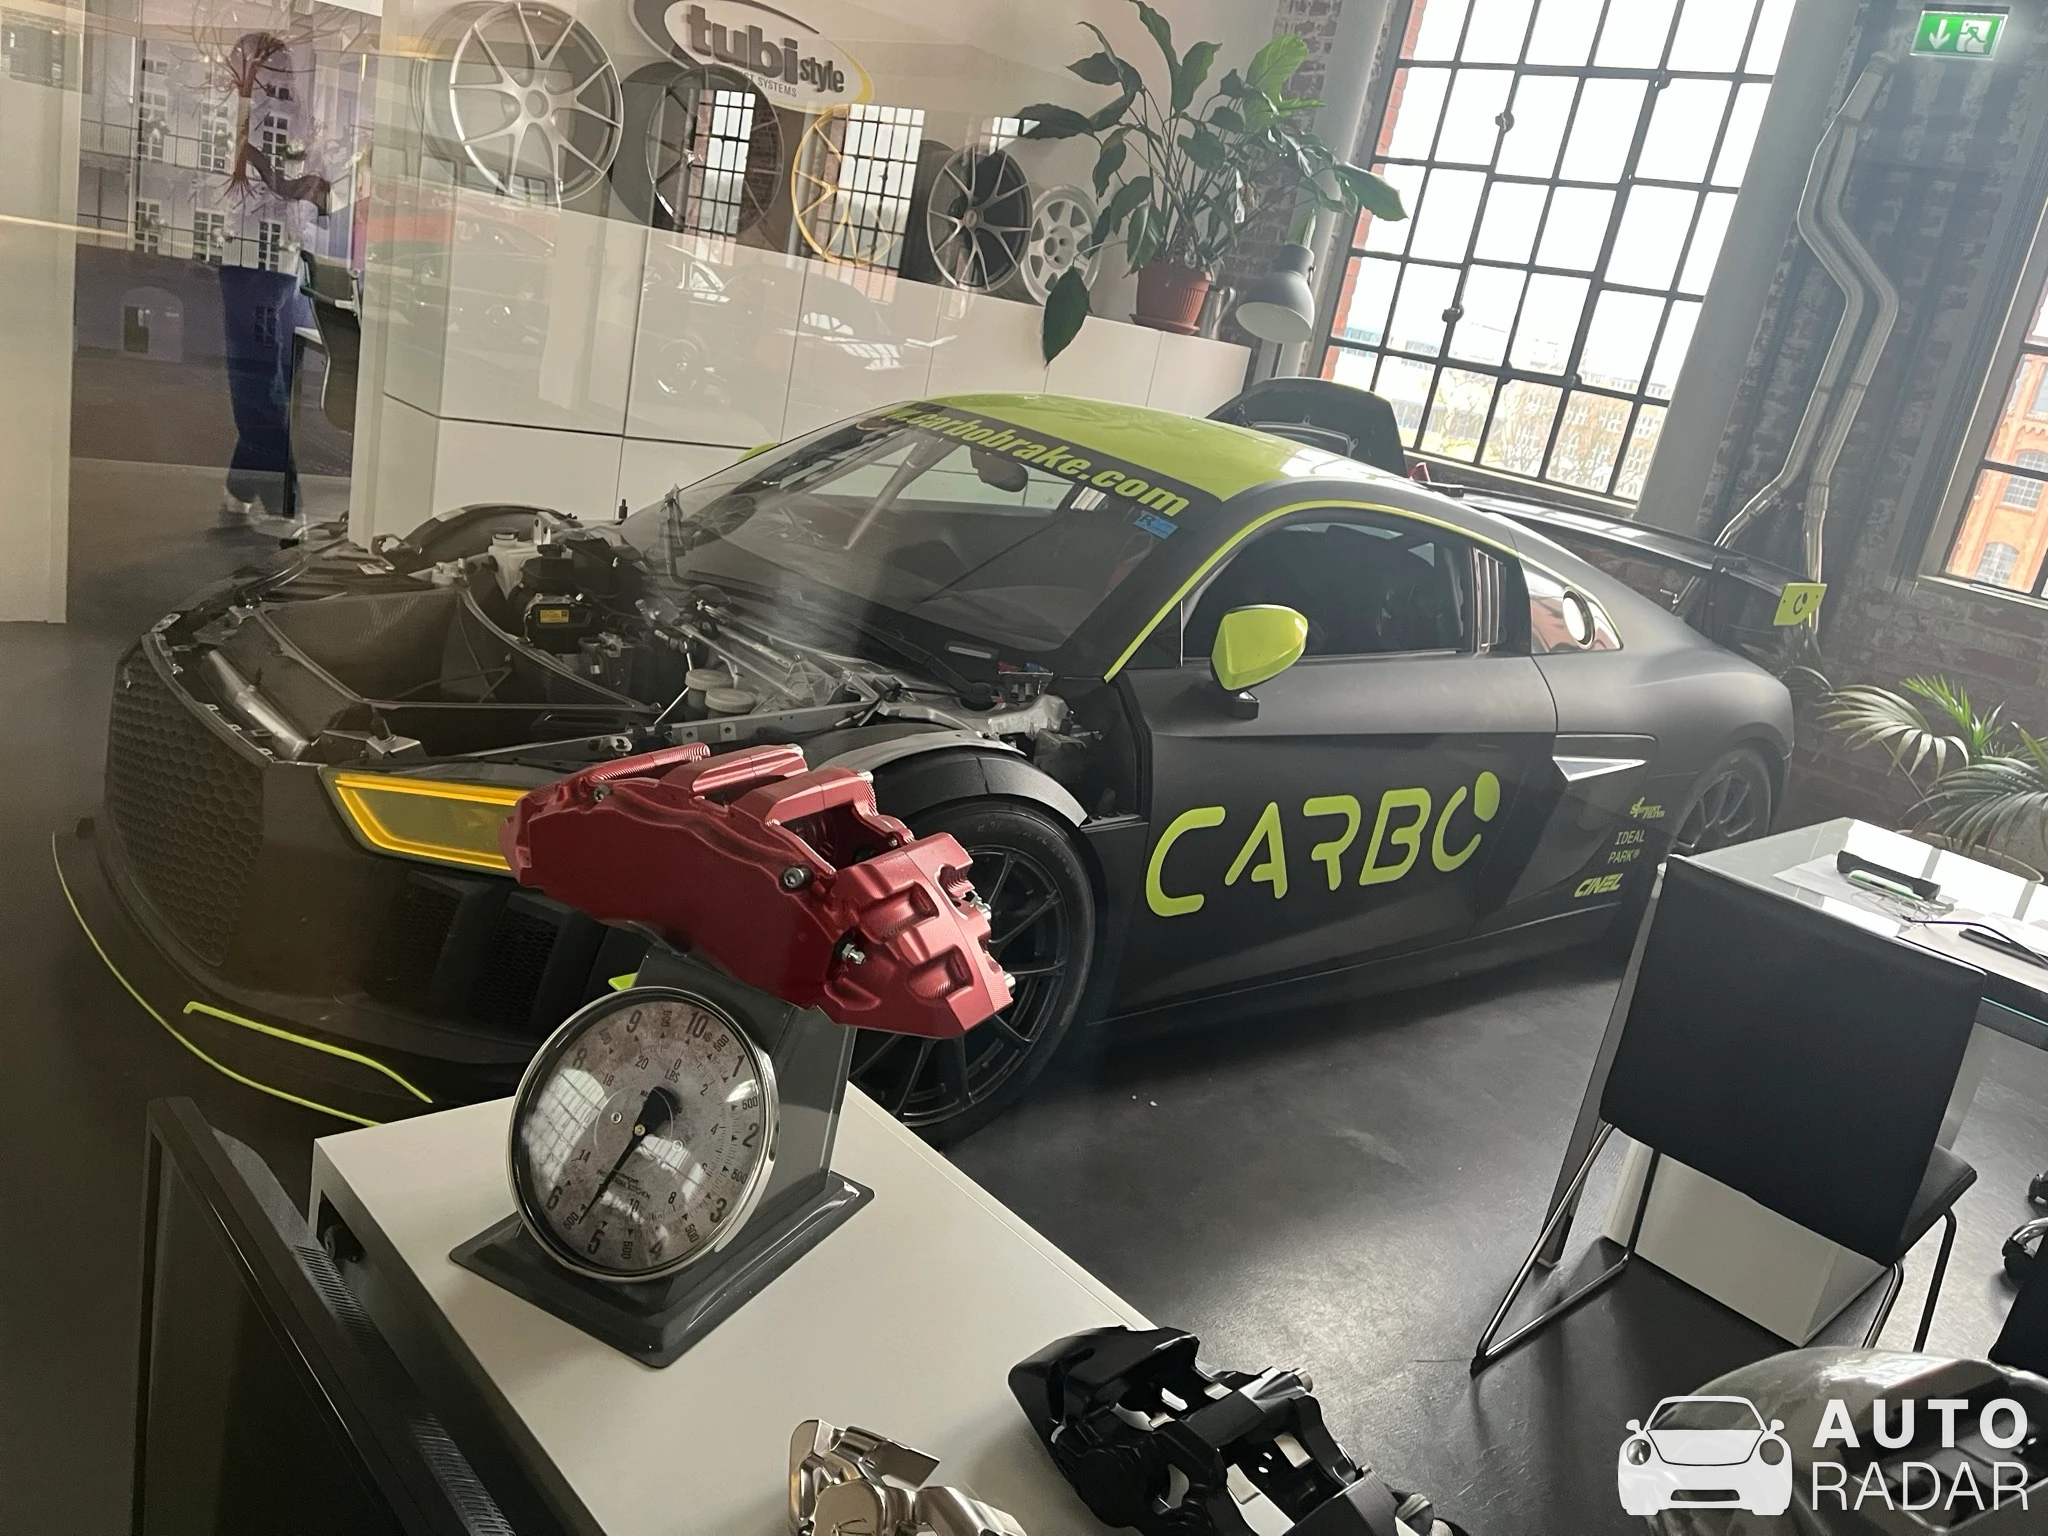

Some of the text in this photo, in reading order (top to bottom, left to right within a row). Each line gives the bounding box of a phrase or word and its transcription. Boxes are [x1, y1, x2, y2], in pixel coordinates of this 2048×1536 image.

[687, 4, 844, 93] tubi style
[757, 76, 797, 97] SYSTEMS
[1615, 830, 1645, 846] IDEAL
[1574, 873, 1624, 898] CINEL
[626, 1009, 643, 1034] 9
[686, 1010, 709, 1039] 10
[635, 1055, 650, 1071] 20
[732, 1053, 746, 1078] 1
[602, 1073, 615, 1088] 18
[664, 1068, 681, 1084] LBS
[700, 1083, 710, 1097] 2
[741, 1095, 759, 1111] 500
[710, 1122, 720, 1136] 4
[741, 1122, 760, 1149] 2
[578, 1148, 592, 1164] 14
[730, 1168, 749, 1185] 500
[545, 1185, 564, 1212] 6
[667, 1191, 677, 1205] 8
[709, 1197, 728, 1224] 3
[586, 1228, 606, 1256] 5
[684, 1223, 700, 1244] 500
